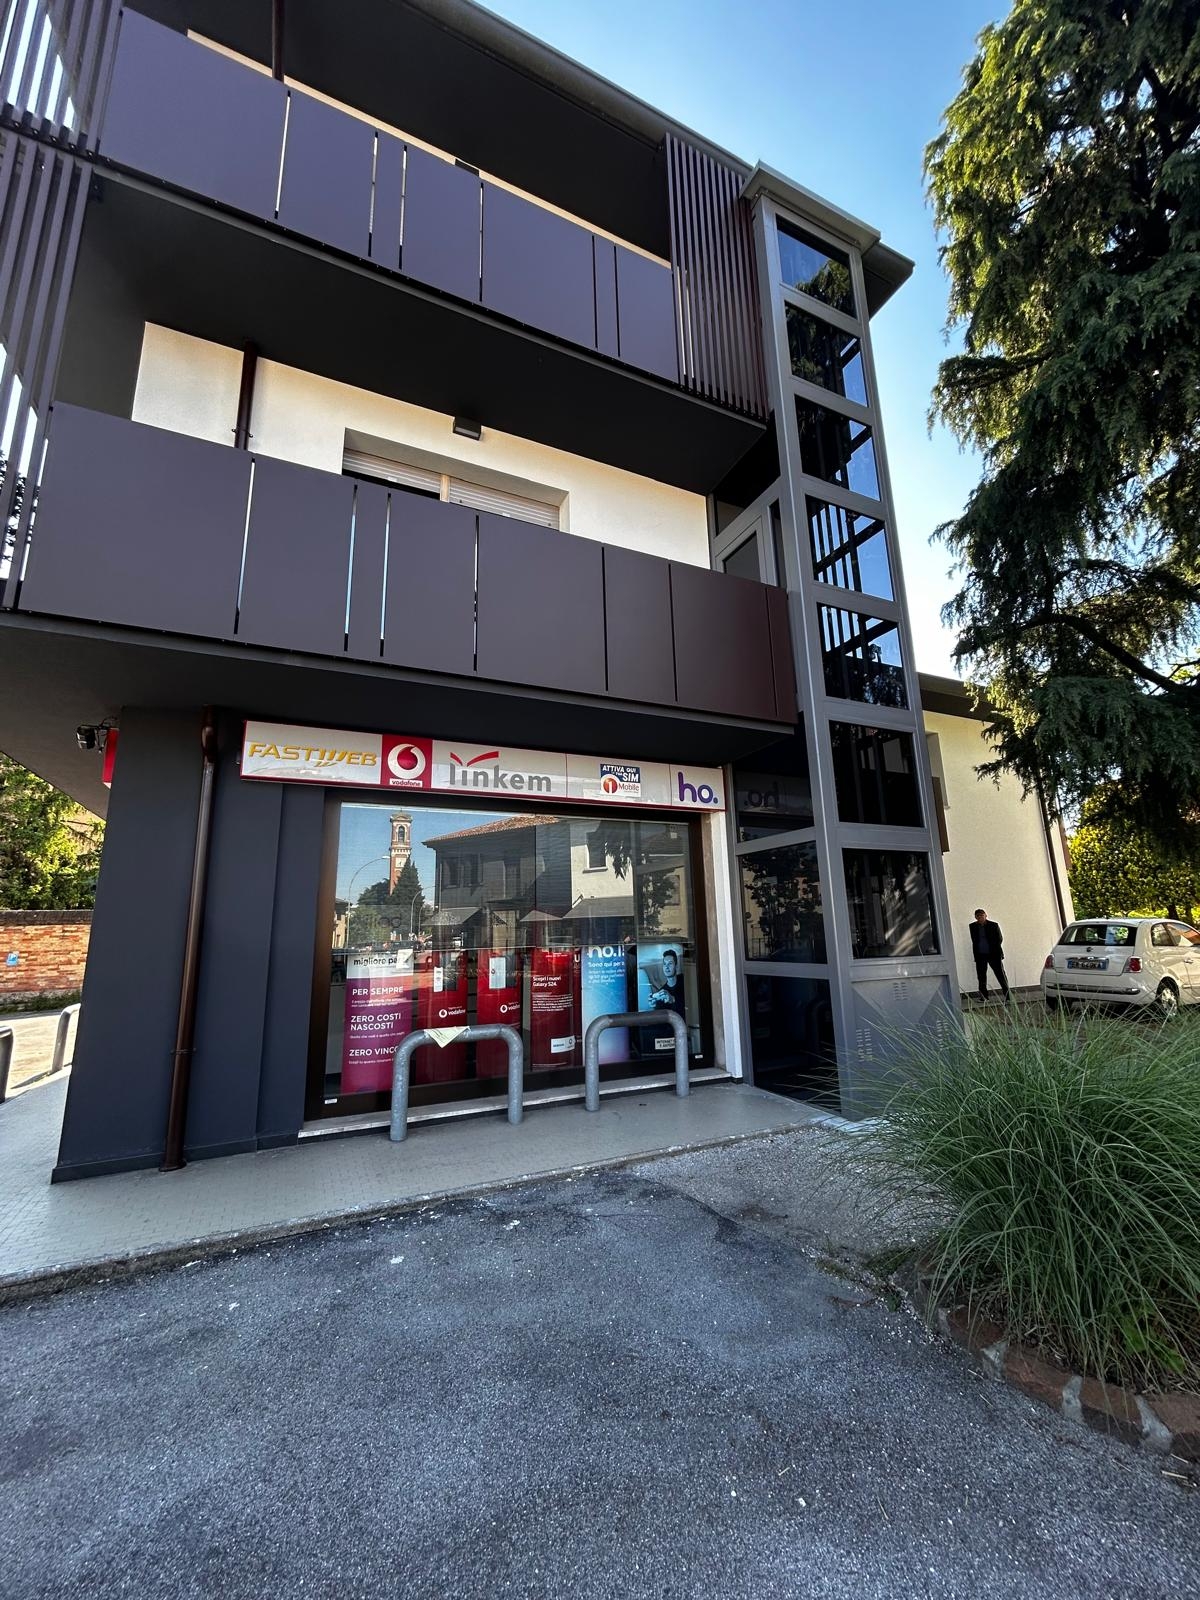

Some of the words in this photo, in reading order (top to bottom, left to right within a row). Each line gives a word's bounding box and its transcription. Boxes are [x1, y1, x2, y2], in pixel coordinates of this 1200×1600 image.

[248, 742, 377, 768] FASTWEB
[602, 765, 624, 773] ATTIVA
[449, 762, 552, 792] linkem
[622, 772, 639, 783] SIM
[677, 771, 718, 804] ho.
[352, 988, 369, 996] PER
[370, 986, 403, 995] SEMPRE
[350, 1014, 375, 1023] ZERO
[376, 1012, 401, 1022] COSTI
[350, 1021, 394, 1031] NASCOSTI
[349, 1048, 373, 1057] ZERO
